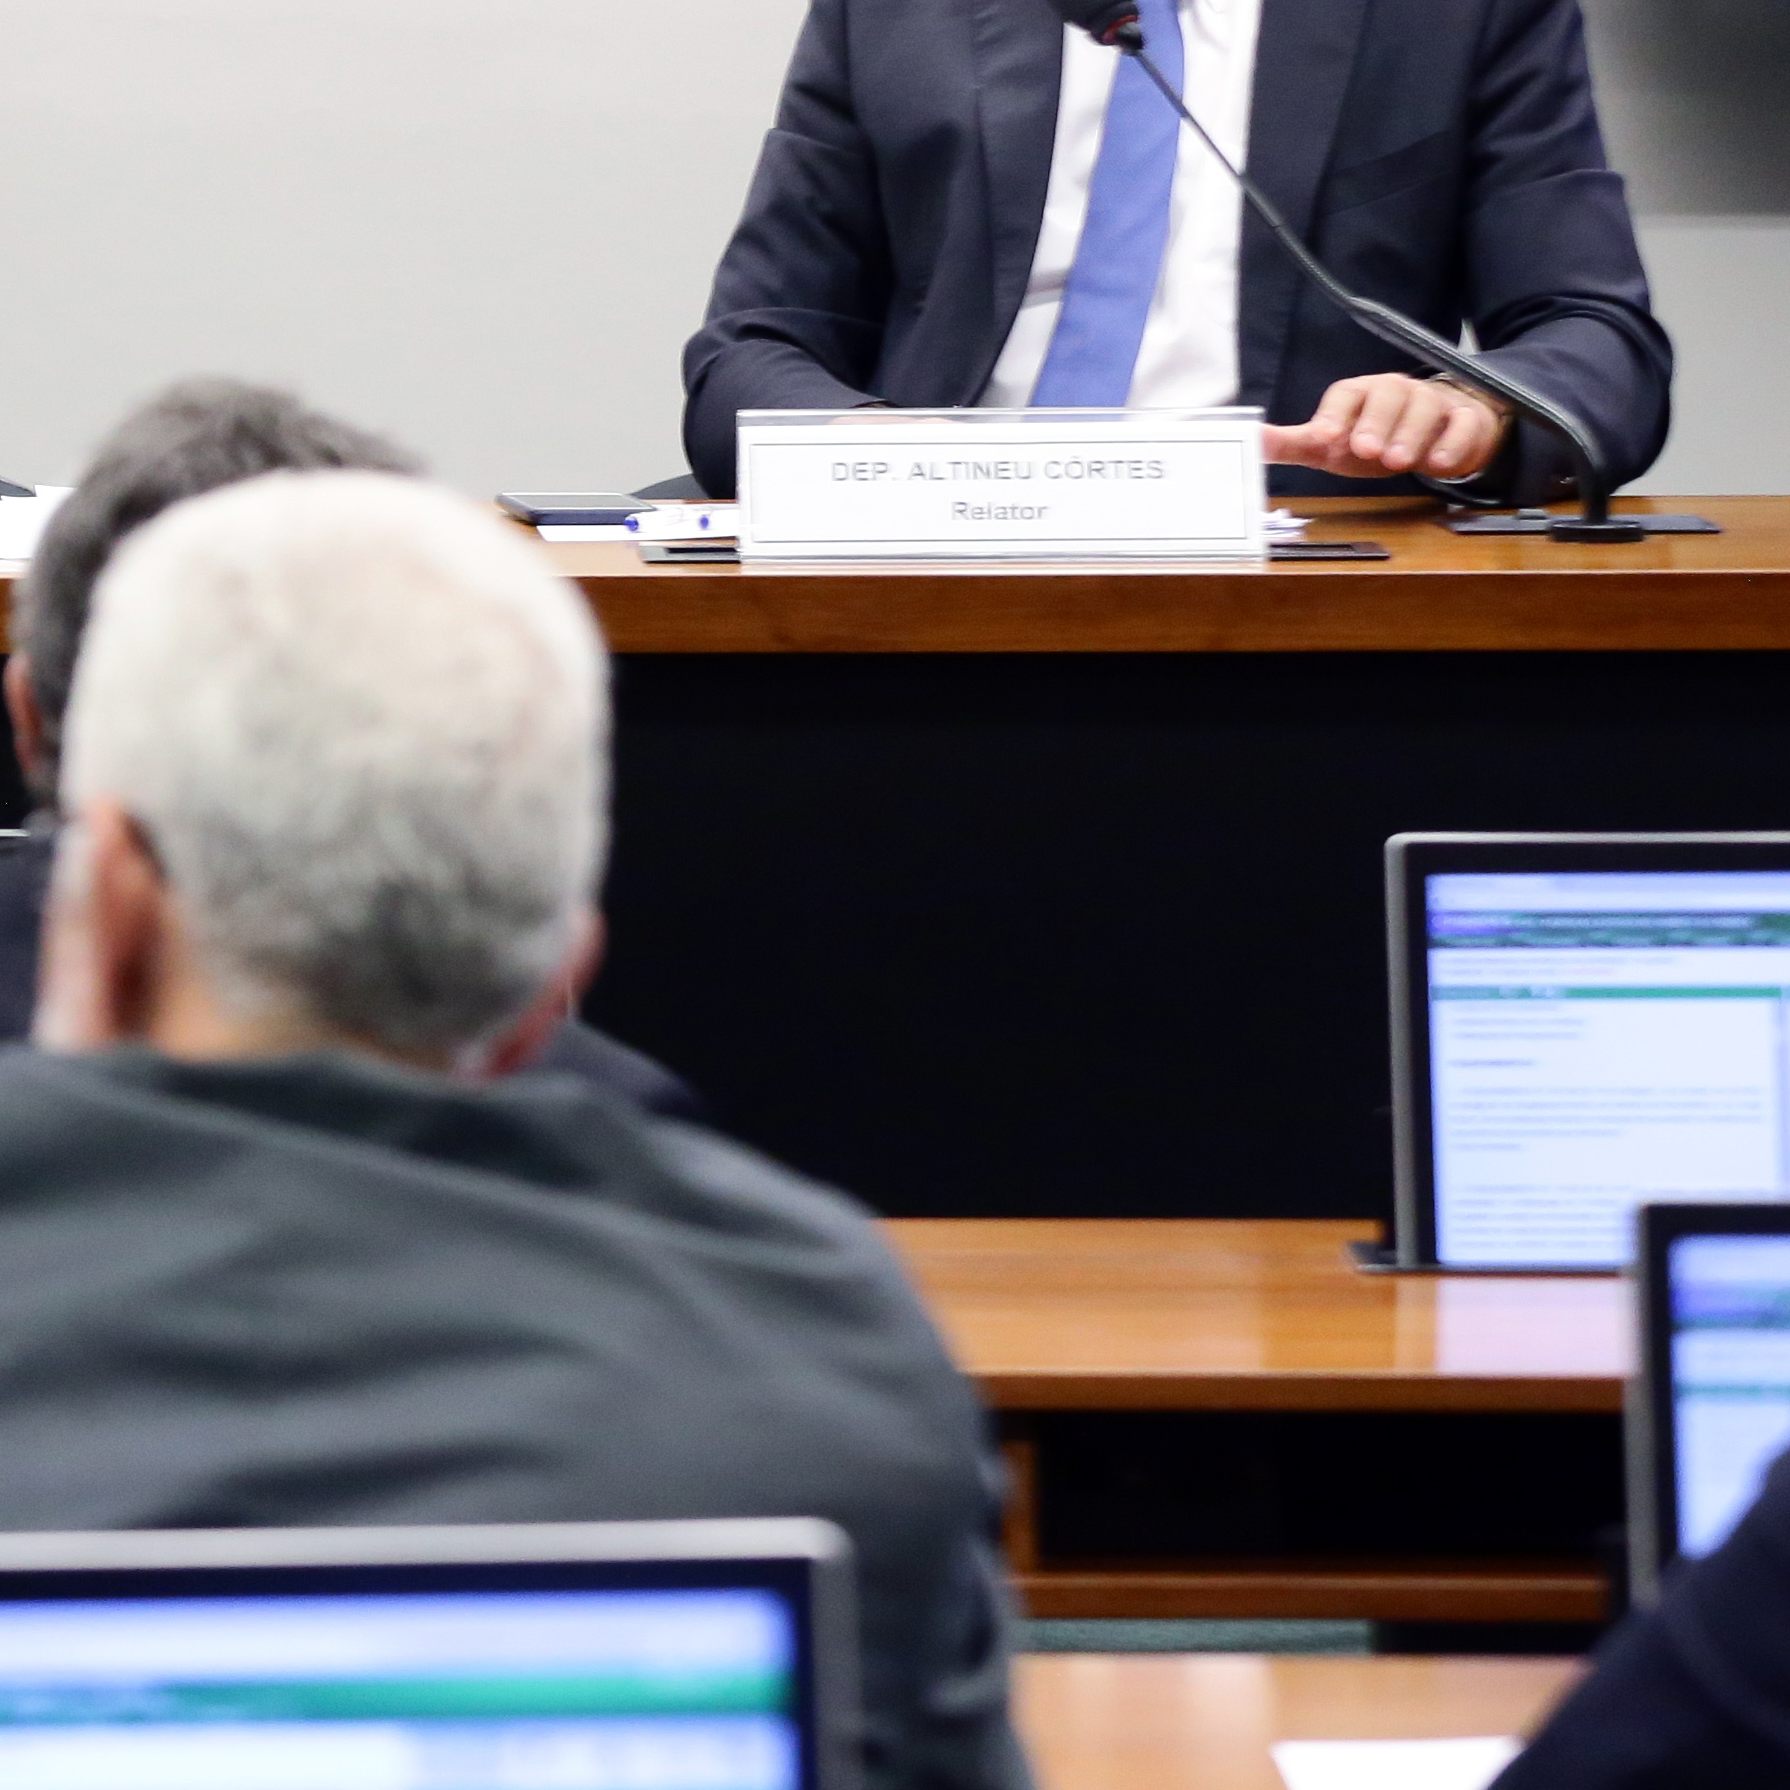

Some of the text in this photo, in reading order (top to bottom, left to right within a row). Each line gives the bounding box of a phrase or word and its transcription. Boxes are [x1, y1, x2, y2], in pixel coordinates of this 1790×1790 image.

[830, 461, 900, 482] DEP.
[907, 460, 1034, 481] ALTINEU
[950, 501, 1048, 521] Relator
